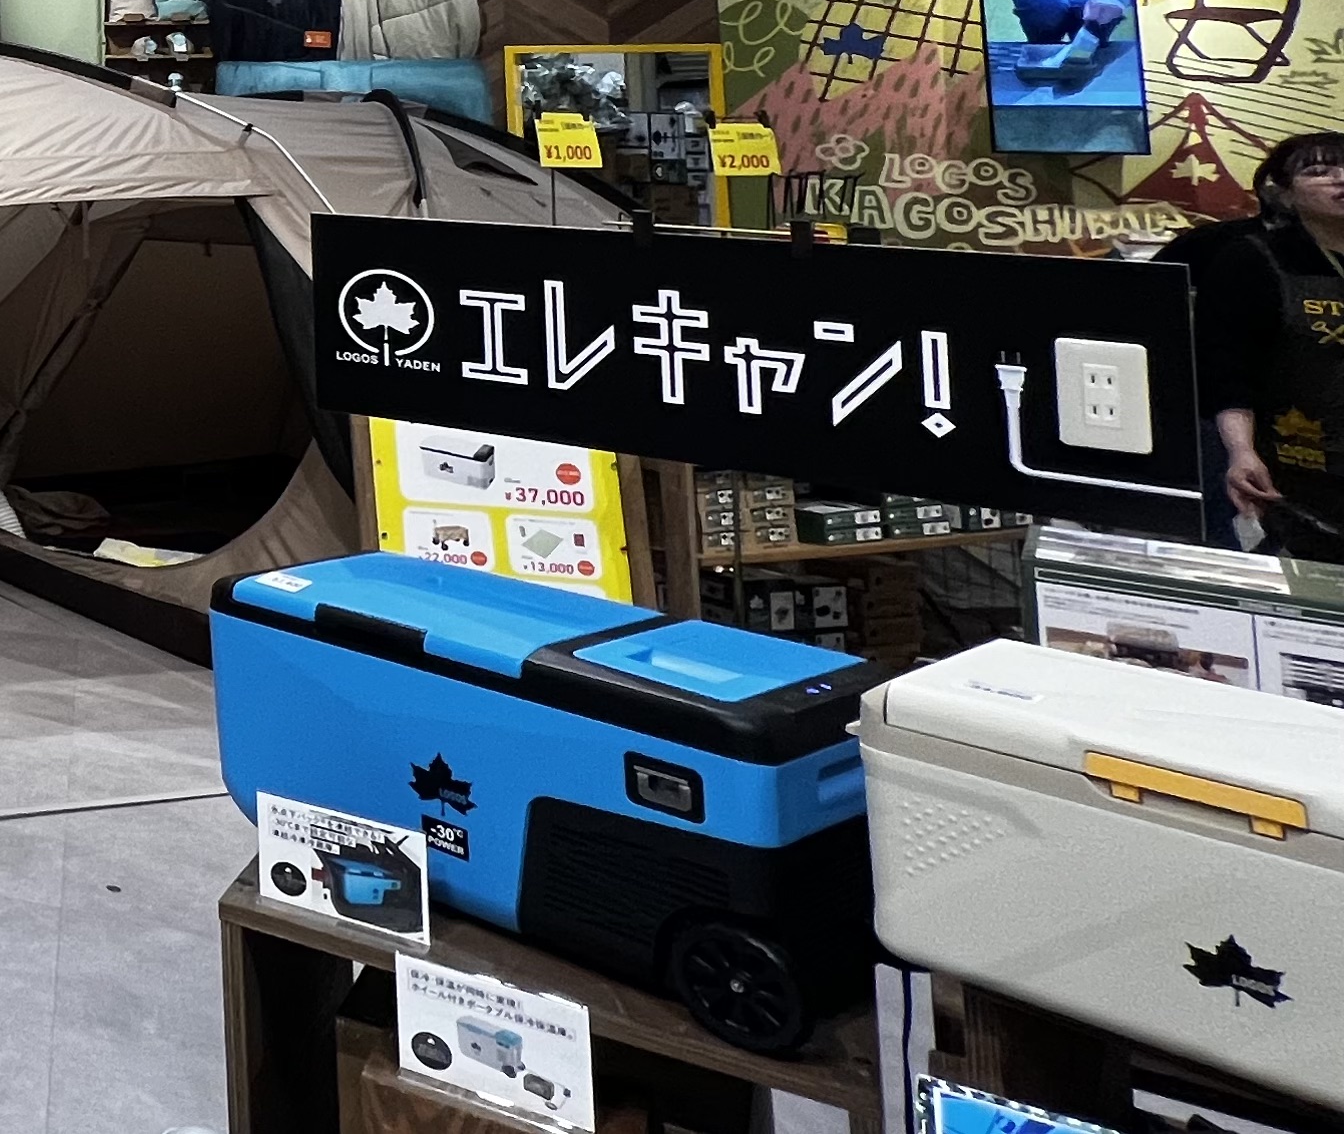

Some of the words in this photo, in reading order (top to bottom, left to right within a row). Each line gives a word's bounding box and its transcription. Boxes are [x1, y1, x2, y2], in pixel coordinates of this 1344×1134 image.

[544, 144, 592, 162] ¥1,000
[717, 154, 770, 171] ¥2,000
[879, 153, 1038, 205] LOGOS
[335, 350, 379, 365] LOGOS
[395, 357, 441, 373] YADEN
[459, 279, 957, 438] エレキャン!
[427, 835, 465, 855] POWER
